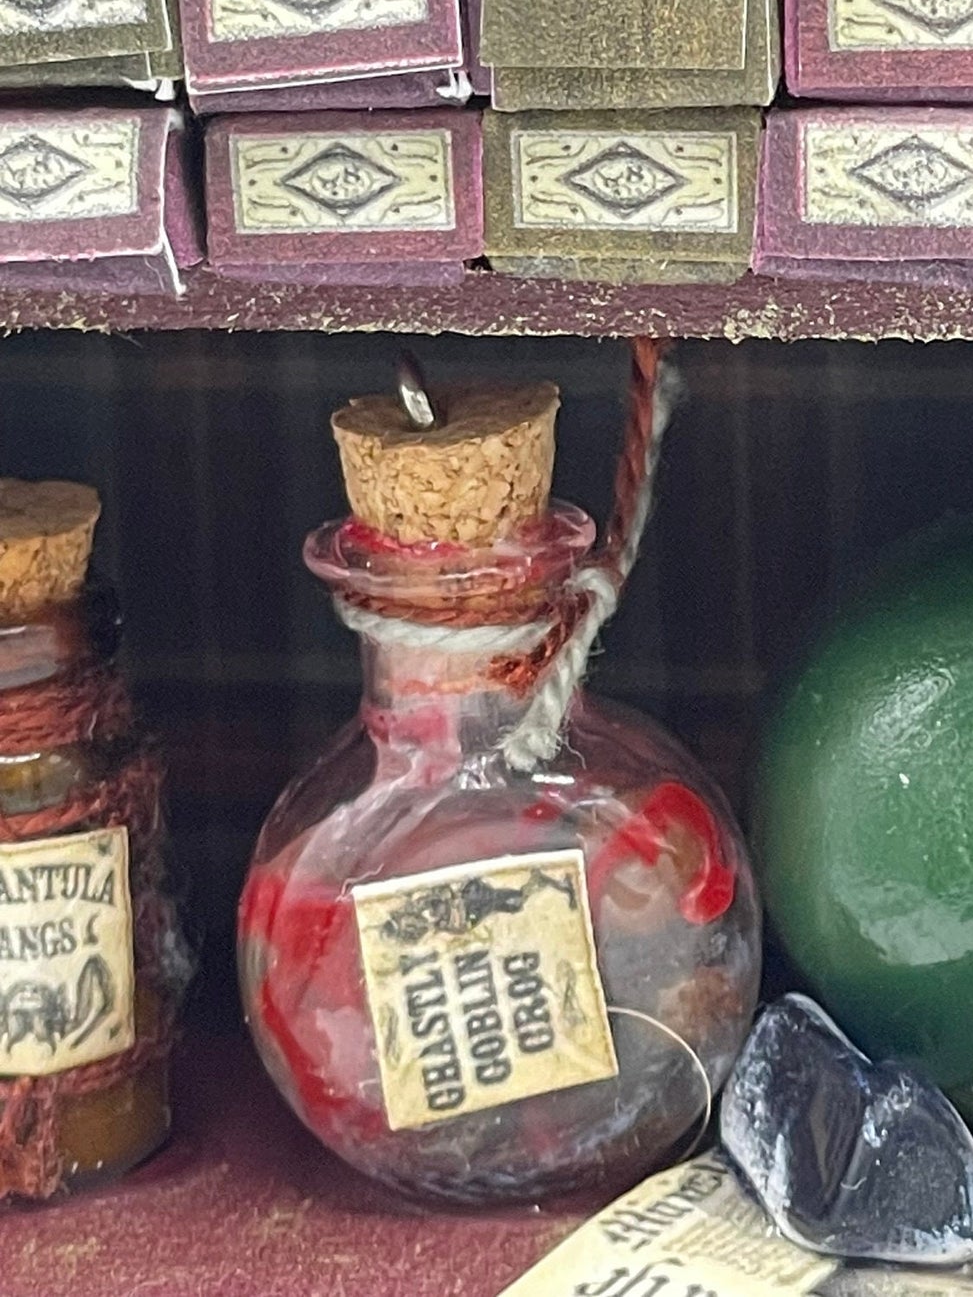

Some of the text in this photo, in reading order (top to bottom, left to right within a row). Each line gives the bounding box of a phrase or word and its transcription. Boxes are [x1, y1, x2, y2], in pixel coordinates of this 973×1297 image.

[399, 950, 466, 1111] GHASTLY
[454, 949, 512, 1085] GOBLIN
[504, 951, 555, 1054] GROG
